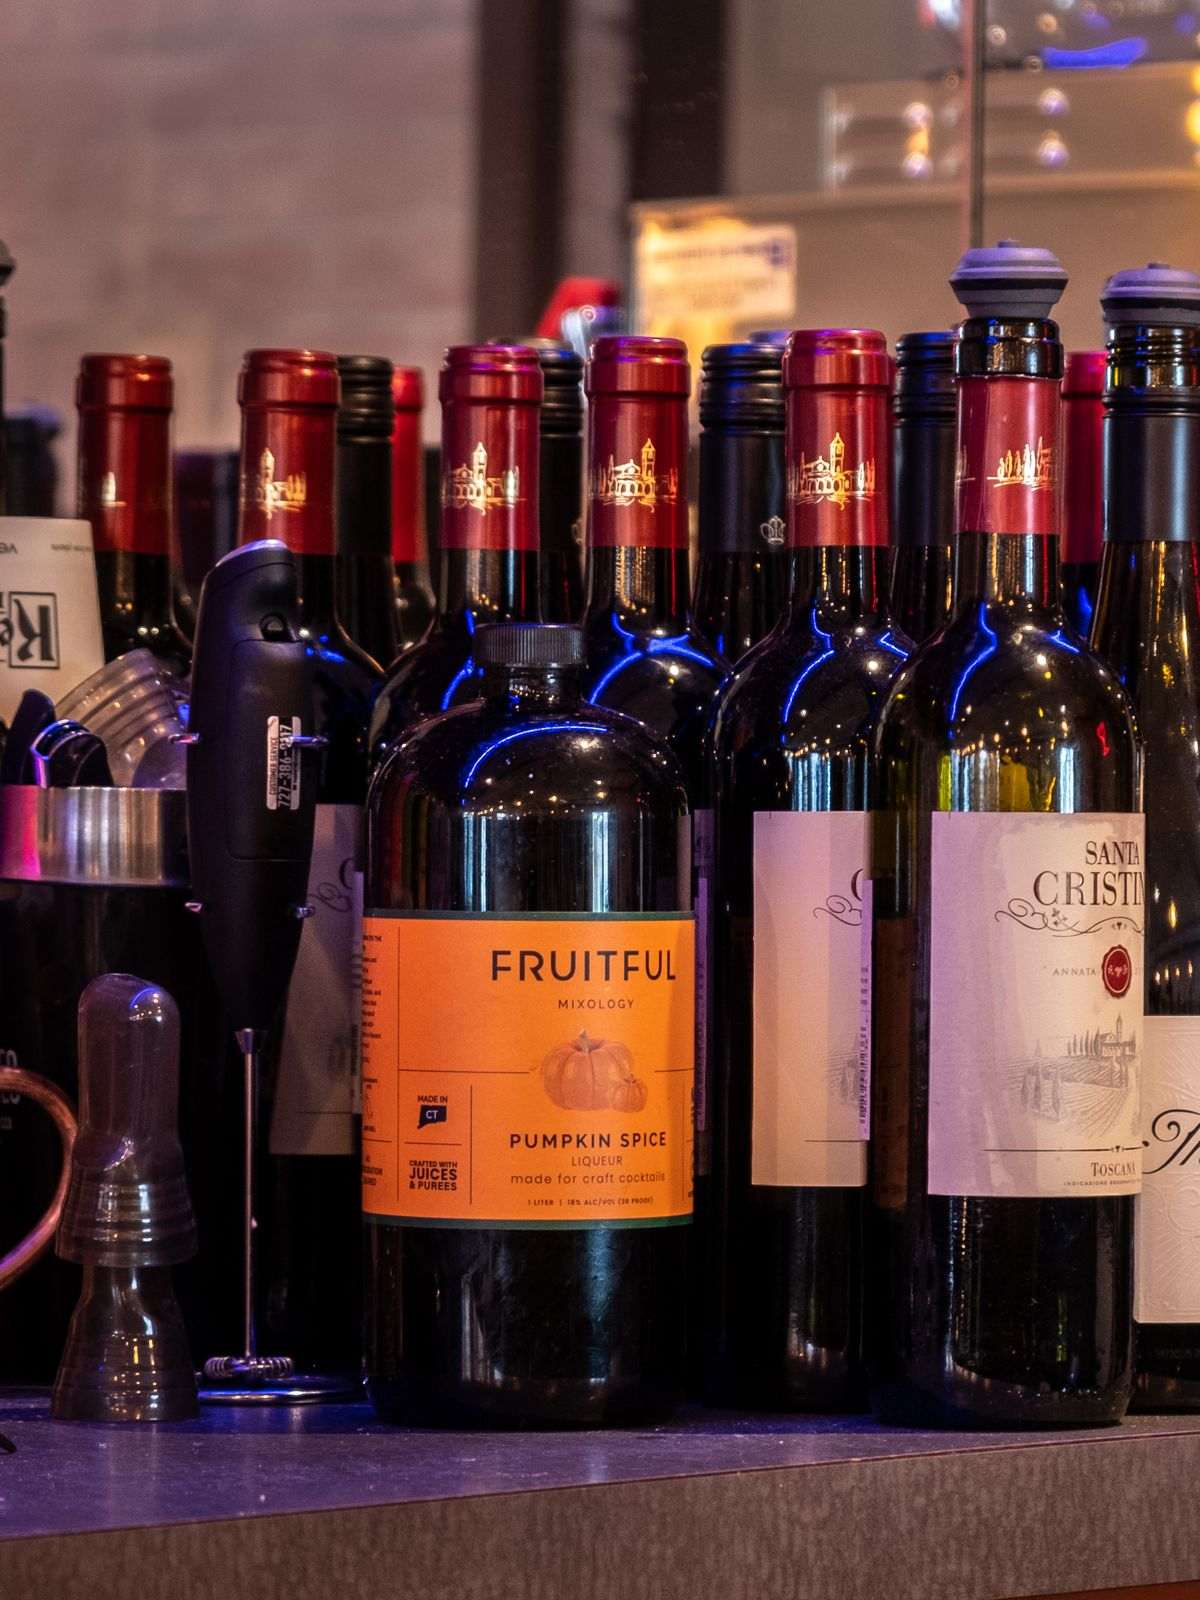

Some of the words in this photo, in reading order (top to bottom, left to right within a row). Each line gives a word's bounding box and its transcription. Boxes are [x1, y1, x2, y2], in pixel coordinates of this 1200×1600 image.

[1085, 840, 1140, 865] SANTA
[491, 950, 677, 982] FRUITFUL
[1053, 967, 1097, 977] ANNATA
[558, 999, 635, 1010] MIXOLOGY
[417, 1095, 439, 1103] MADE
[440, 1096, 448, 1104] IN
[425, 1110, 439, 1119] CT
[510, 1133, 611, 1149] PUMPKIN
[620, 1131, 667, 1147] SPICE
[409, 1160, 438, 1168] CRAFTED
[439, 1161, 457, 1169] WITH
[571, 1155, 623, 1168] LIQUEUR
[409, 1168, 457, 1181] JUICES
[511, 1173, 552, 1185] made
[558, 1172, 577, 1184] for
[583, 1172, 615, 1184] craft
[619, 1171, 666, 1183] cocktails
[409, 1181, 416, 1190] &
[417, 1181, 457, 1191] PUREES
